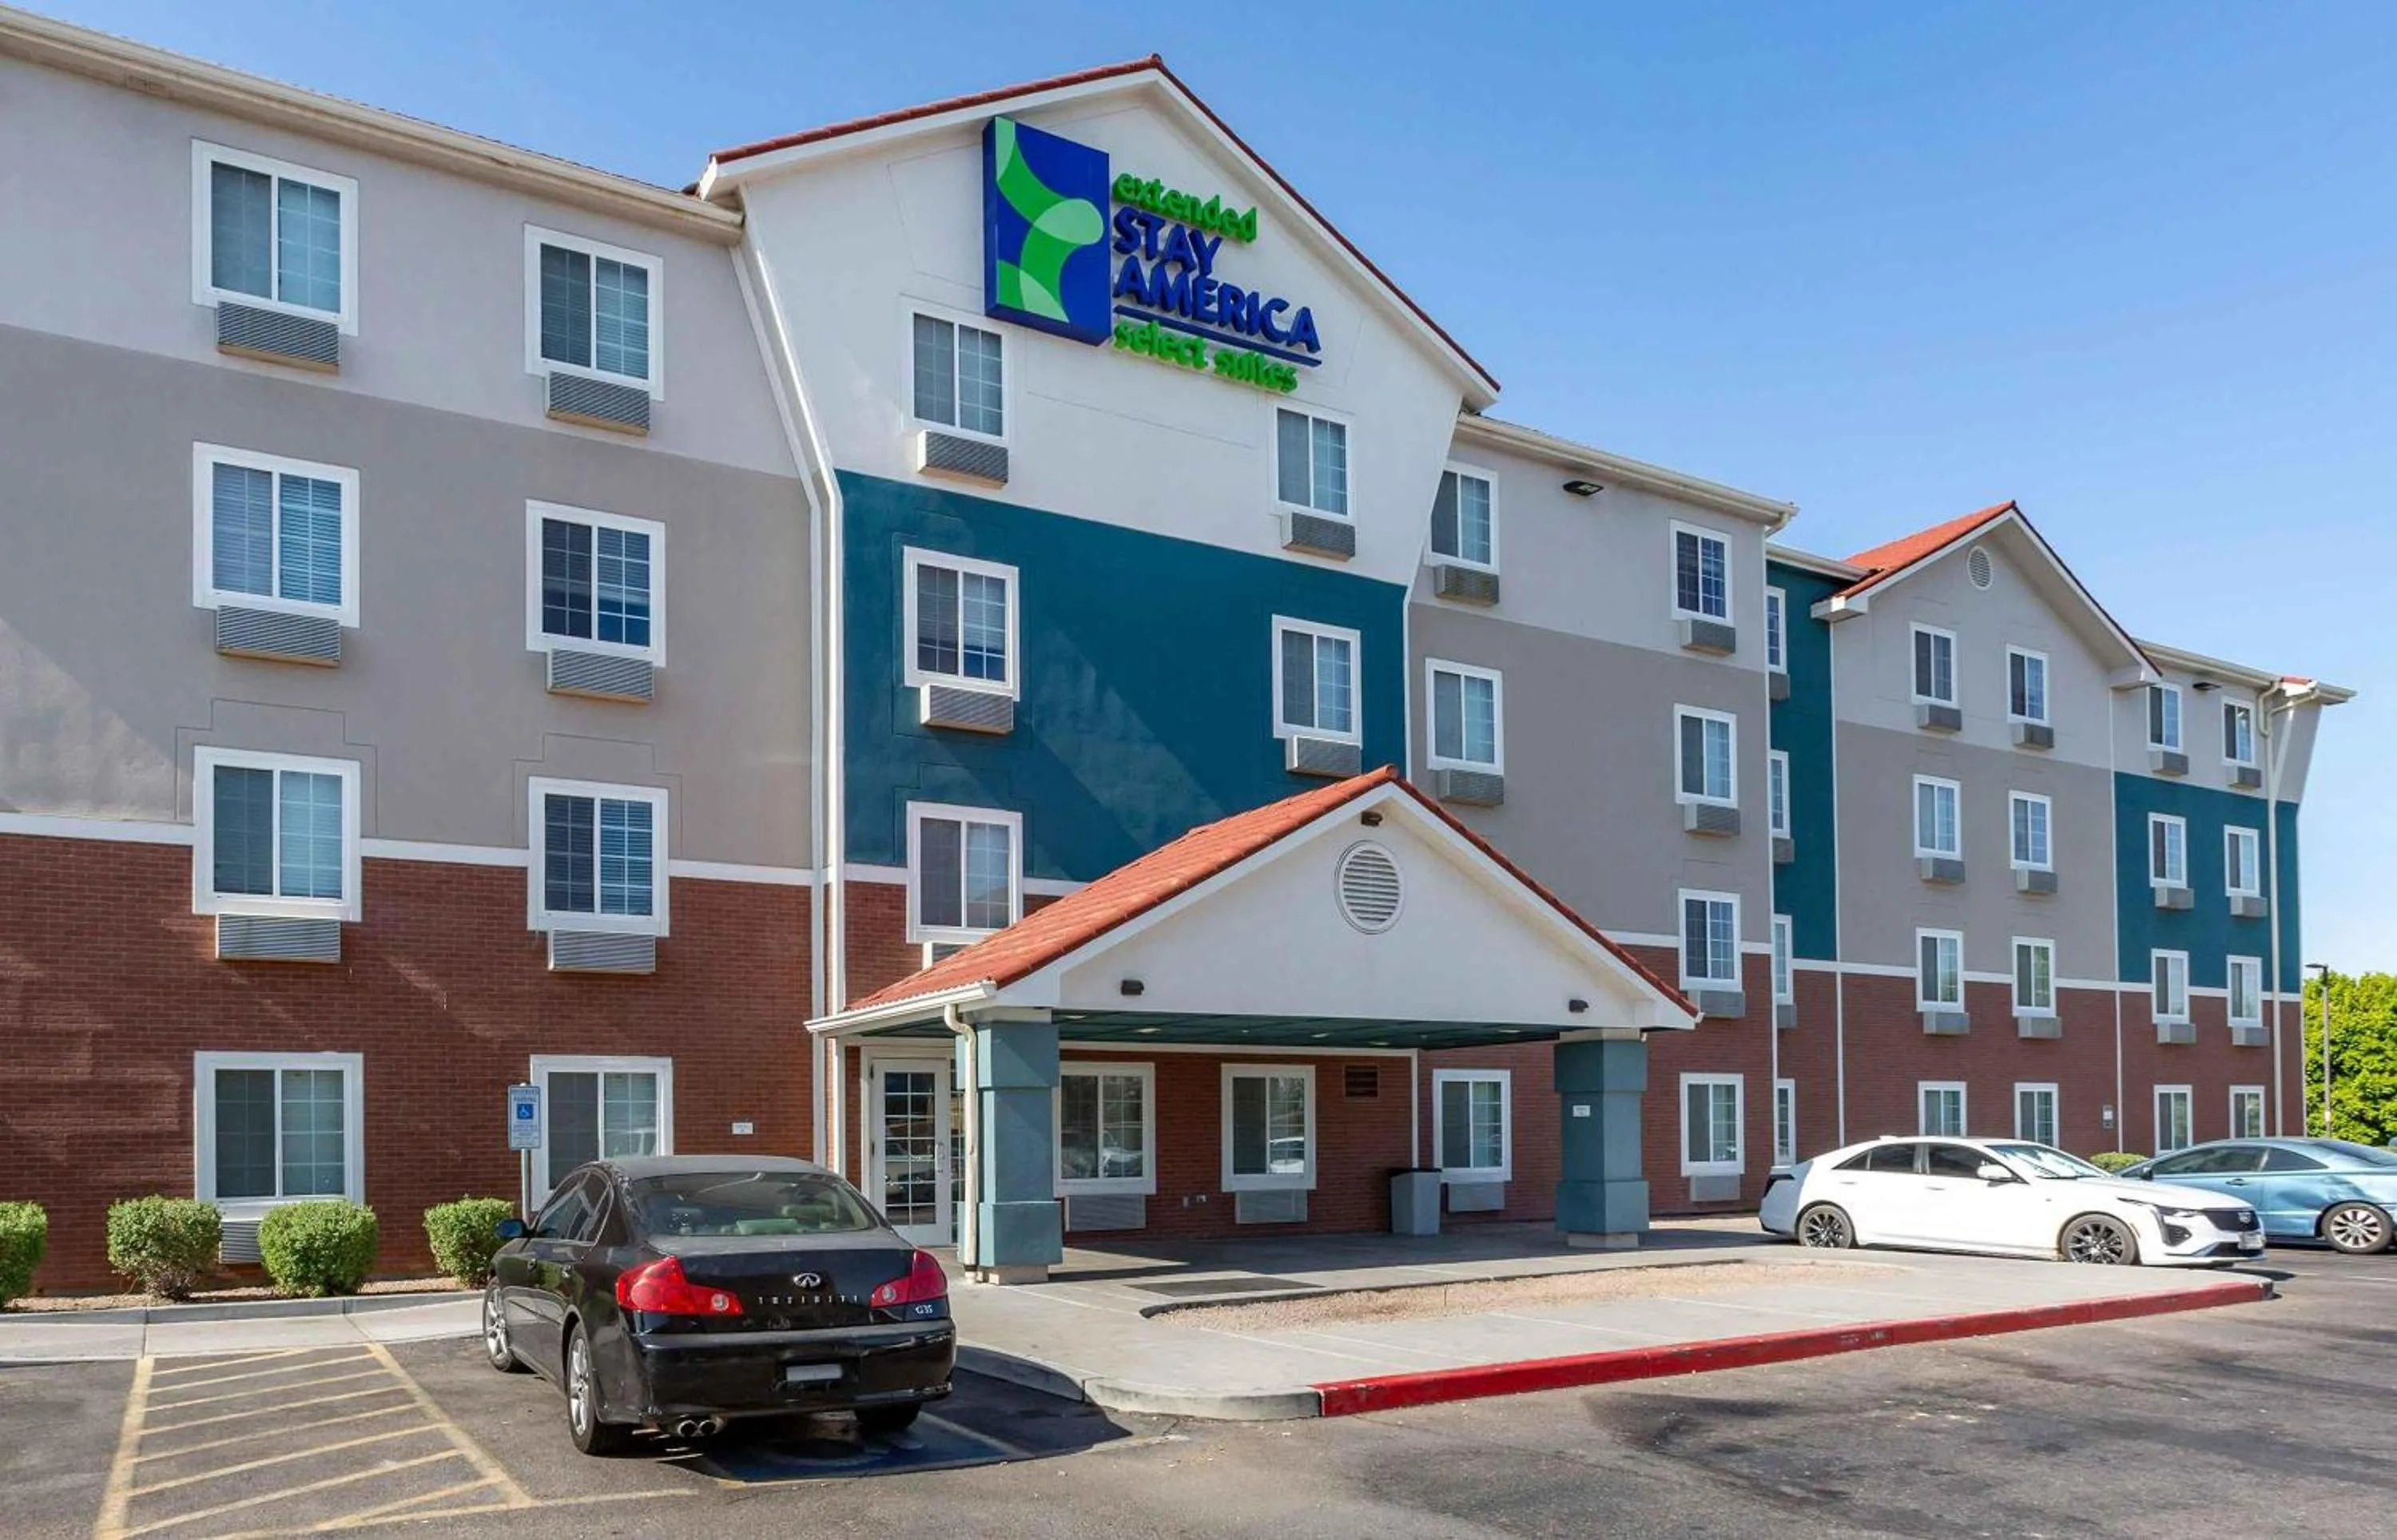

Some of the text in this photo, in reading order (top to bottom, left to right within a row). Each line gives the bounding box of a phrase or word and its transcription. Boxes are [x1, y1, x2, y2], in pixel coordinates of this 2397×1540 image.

[1112, 173, 1258, 243] extended
[1113, 205, 1222, 276] STAY
[1113, 255, 1322, 353] AMERICA
[1113, 320, 1298, 394] select suites
